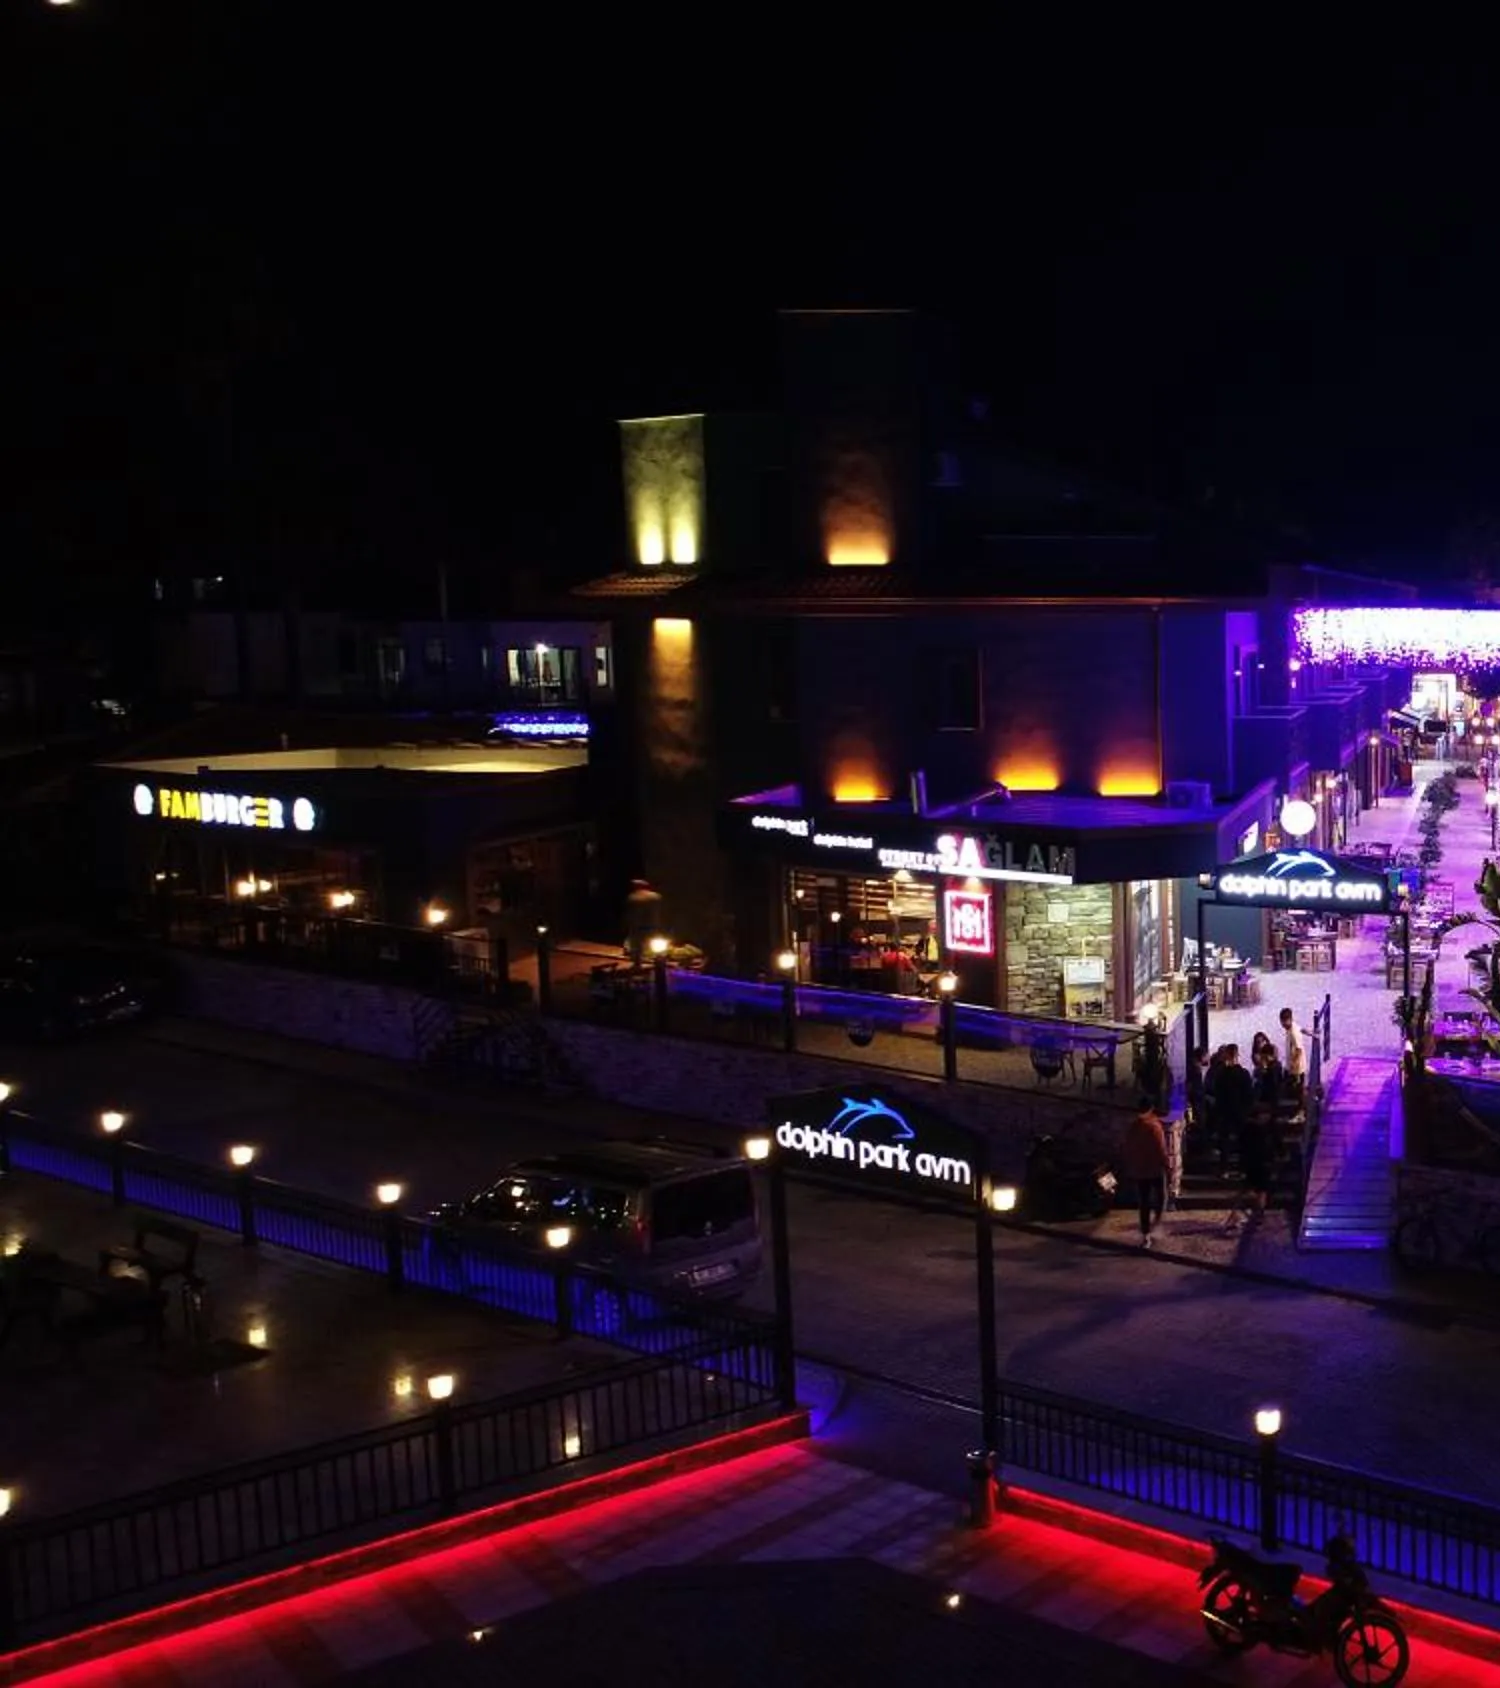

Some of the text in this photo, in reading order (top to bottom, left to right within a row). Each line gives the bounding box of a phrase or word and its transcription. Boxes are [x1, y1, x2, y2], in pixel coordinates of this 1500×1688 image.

[159, 789, 285, 829] FAMBURGER
[1219, 872, 1287, 898] dolphin
[1289, 878, 1333, 900] park
[776, 1121, 972, 1185] dolphin park avm
